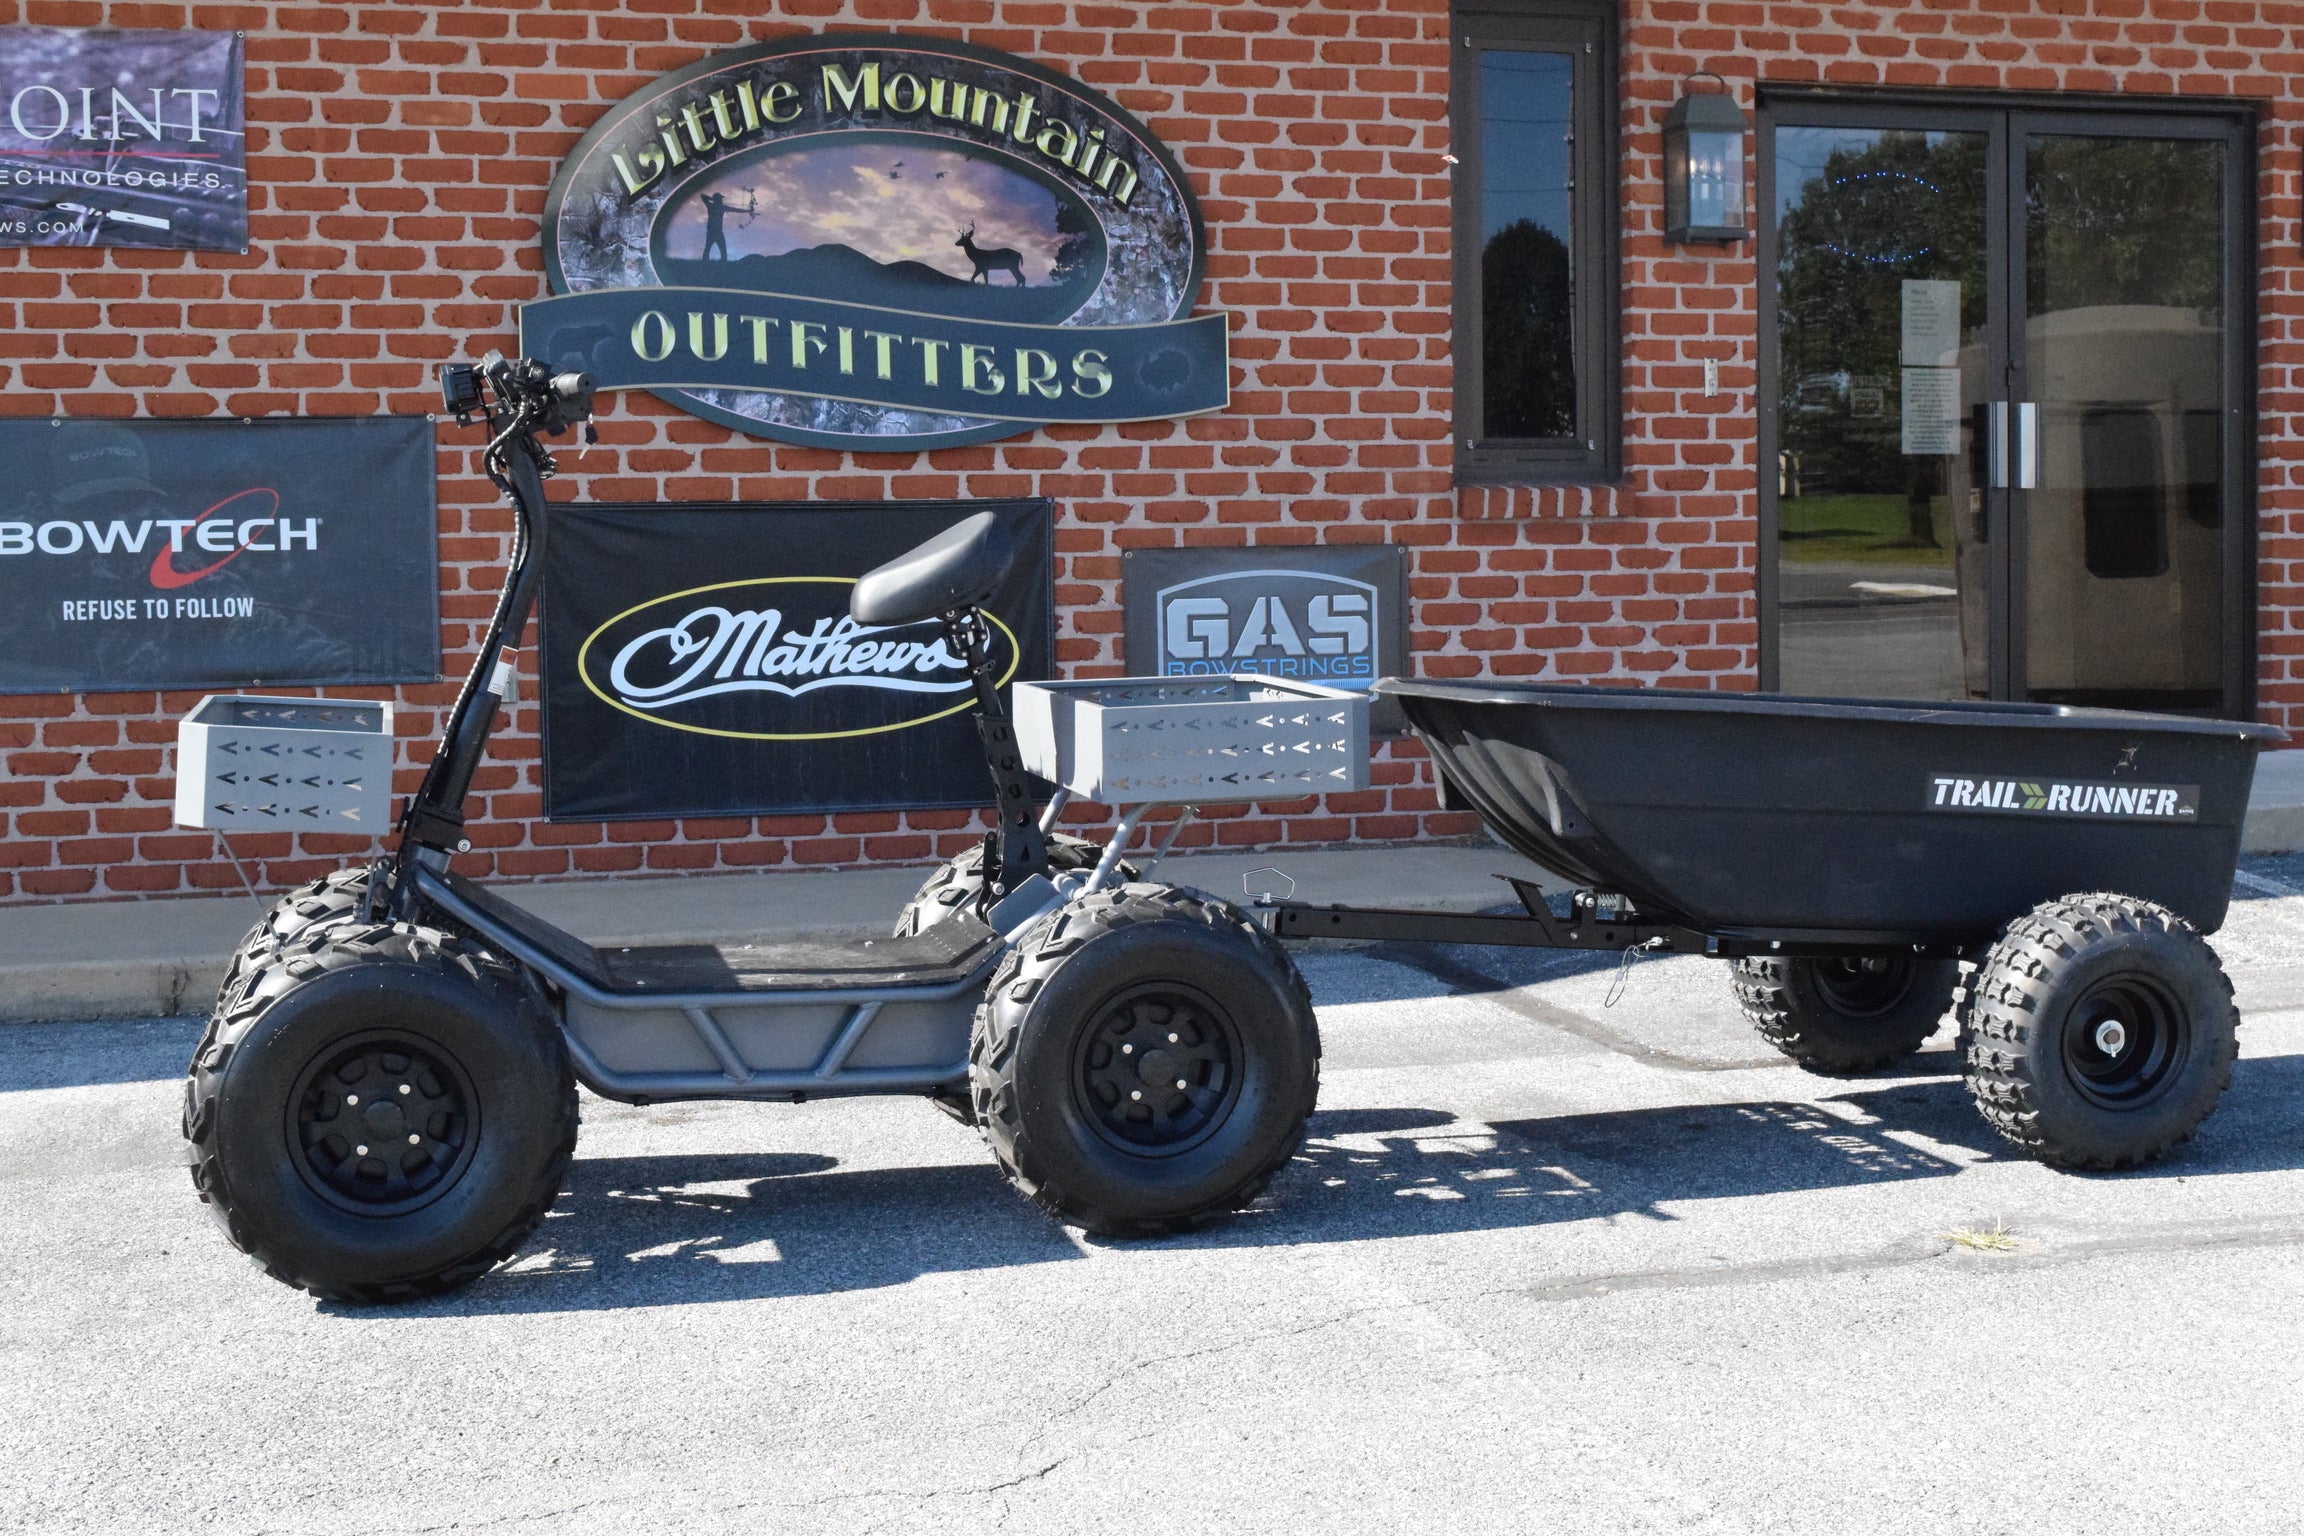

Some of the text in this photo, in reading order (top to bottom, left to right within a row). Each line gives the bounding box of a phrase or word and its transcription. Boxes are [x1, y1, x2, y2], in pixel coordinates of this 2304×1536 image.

[10, 85, 219, 143] OINT
[611, 62, 1140, 204] Little Mountain
[630, 310, 1113, 399] OUTFITTERS
[0, 517, 318, 555] BOWTECH
[63, 597, 255, 621] REFUSE TO FOLLOW
[1166, 594, 1369, 659] GAS
[609, 606, 975, 699] Mathews
[1166, 656, 1371, 677] BOWSTRINGS
[1934, 778, 2178, 815] TRAIL RUNNER
